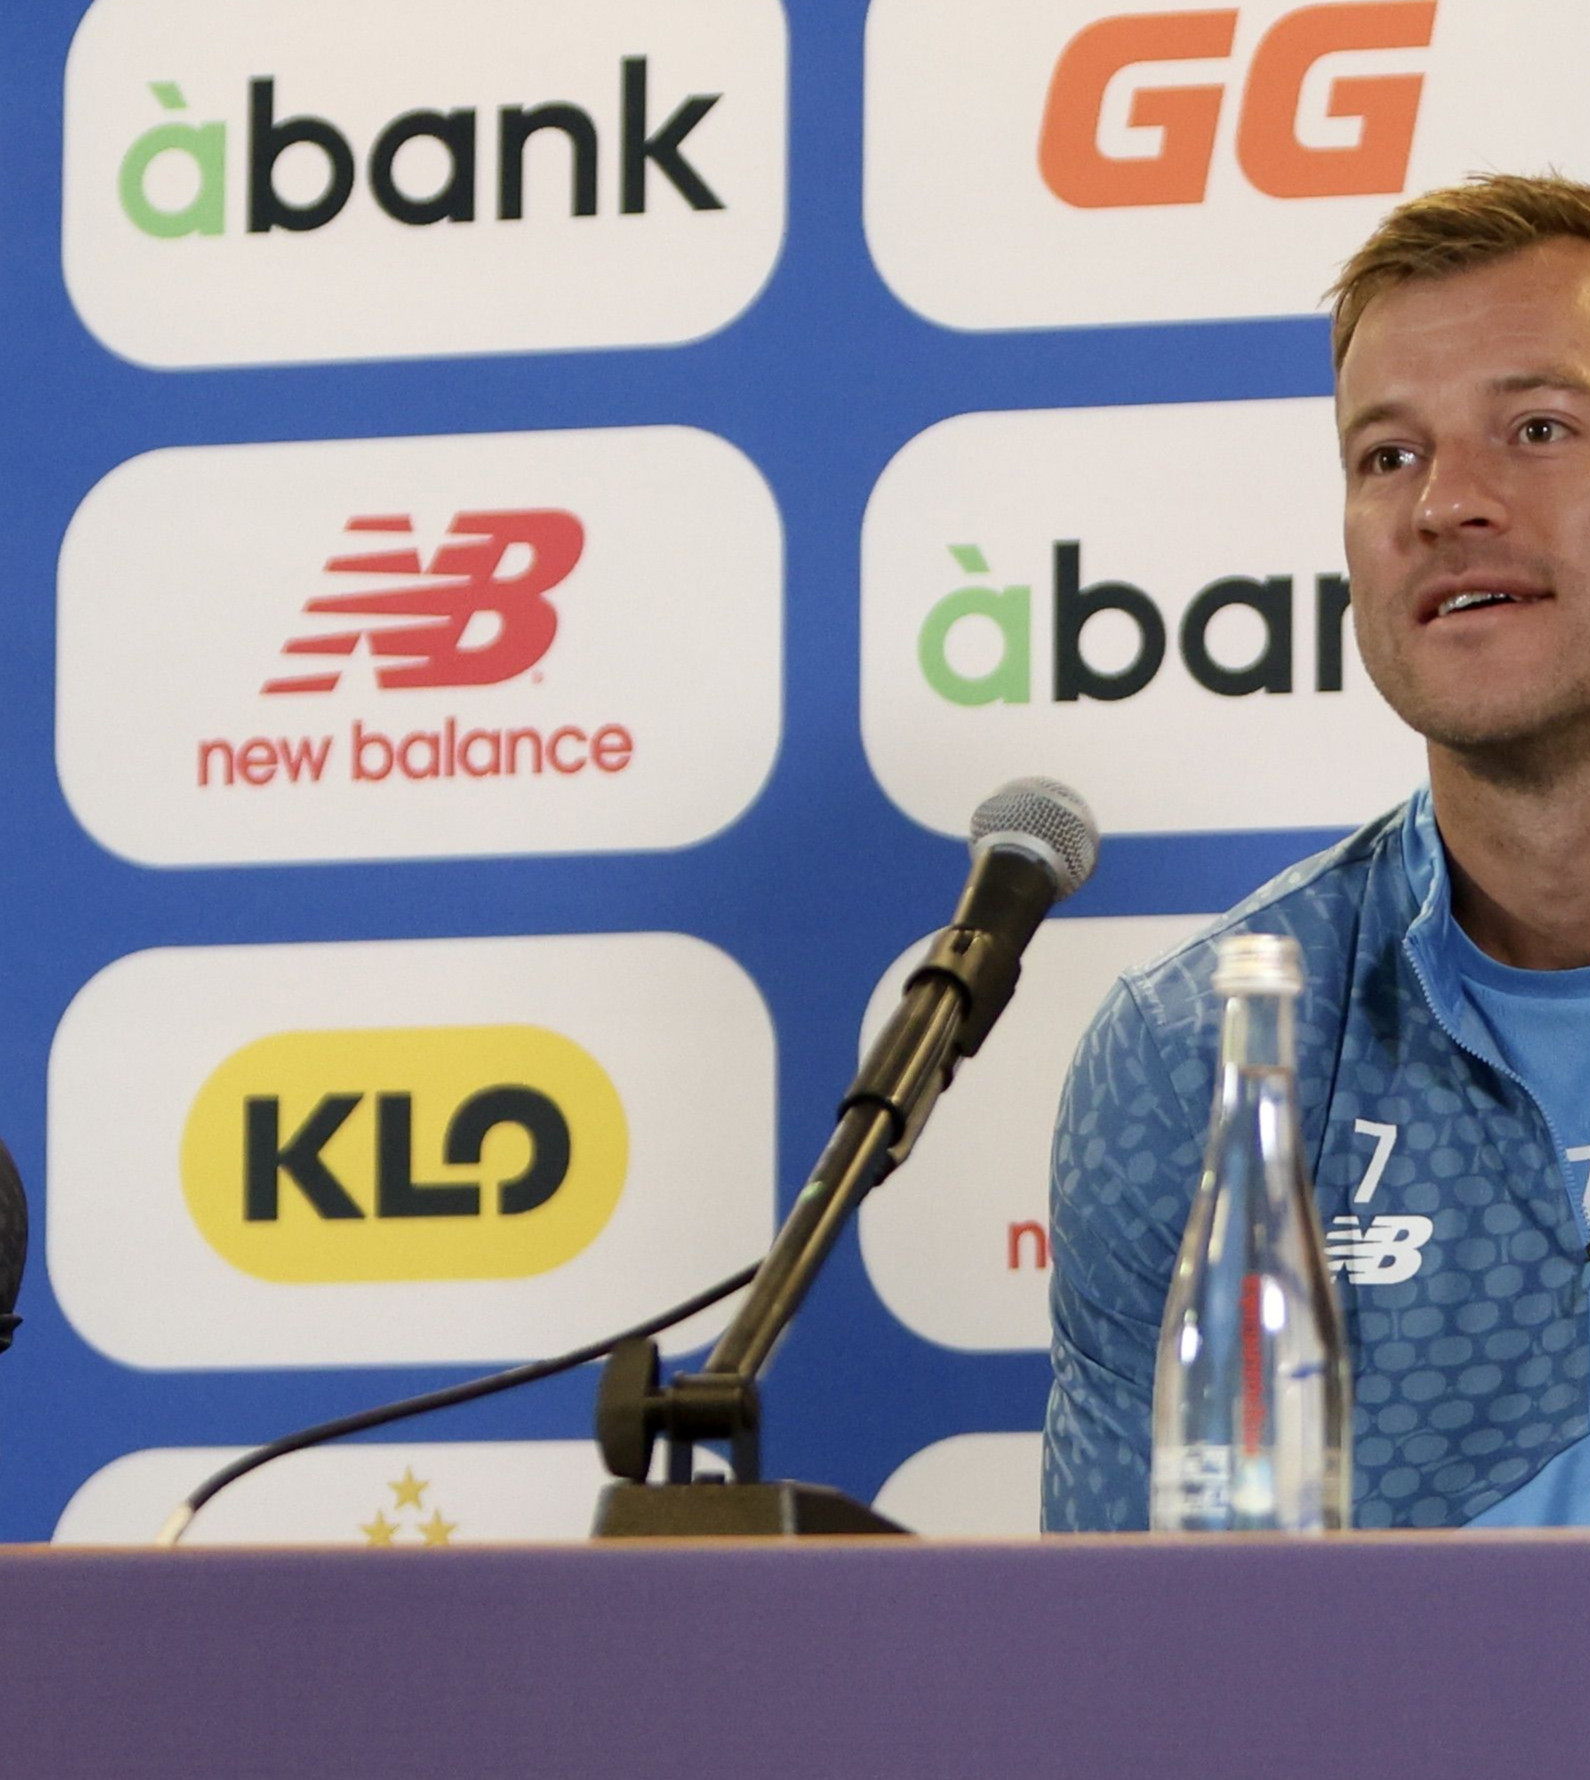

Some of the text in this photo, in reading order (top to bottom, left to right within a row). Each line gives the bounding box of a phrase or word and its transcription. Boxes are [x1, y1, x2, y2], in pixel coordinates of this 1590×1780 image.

[118, 54, 725, 238] àbank
[1037, 0, 1438, 208] GG
[917, 539, 1352, 706] àba
[198, 718, 634, 788] new balance
[243, 1084, 572, 1223] KLO
[1354, 1118, 1398, 1203] 7
